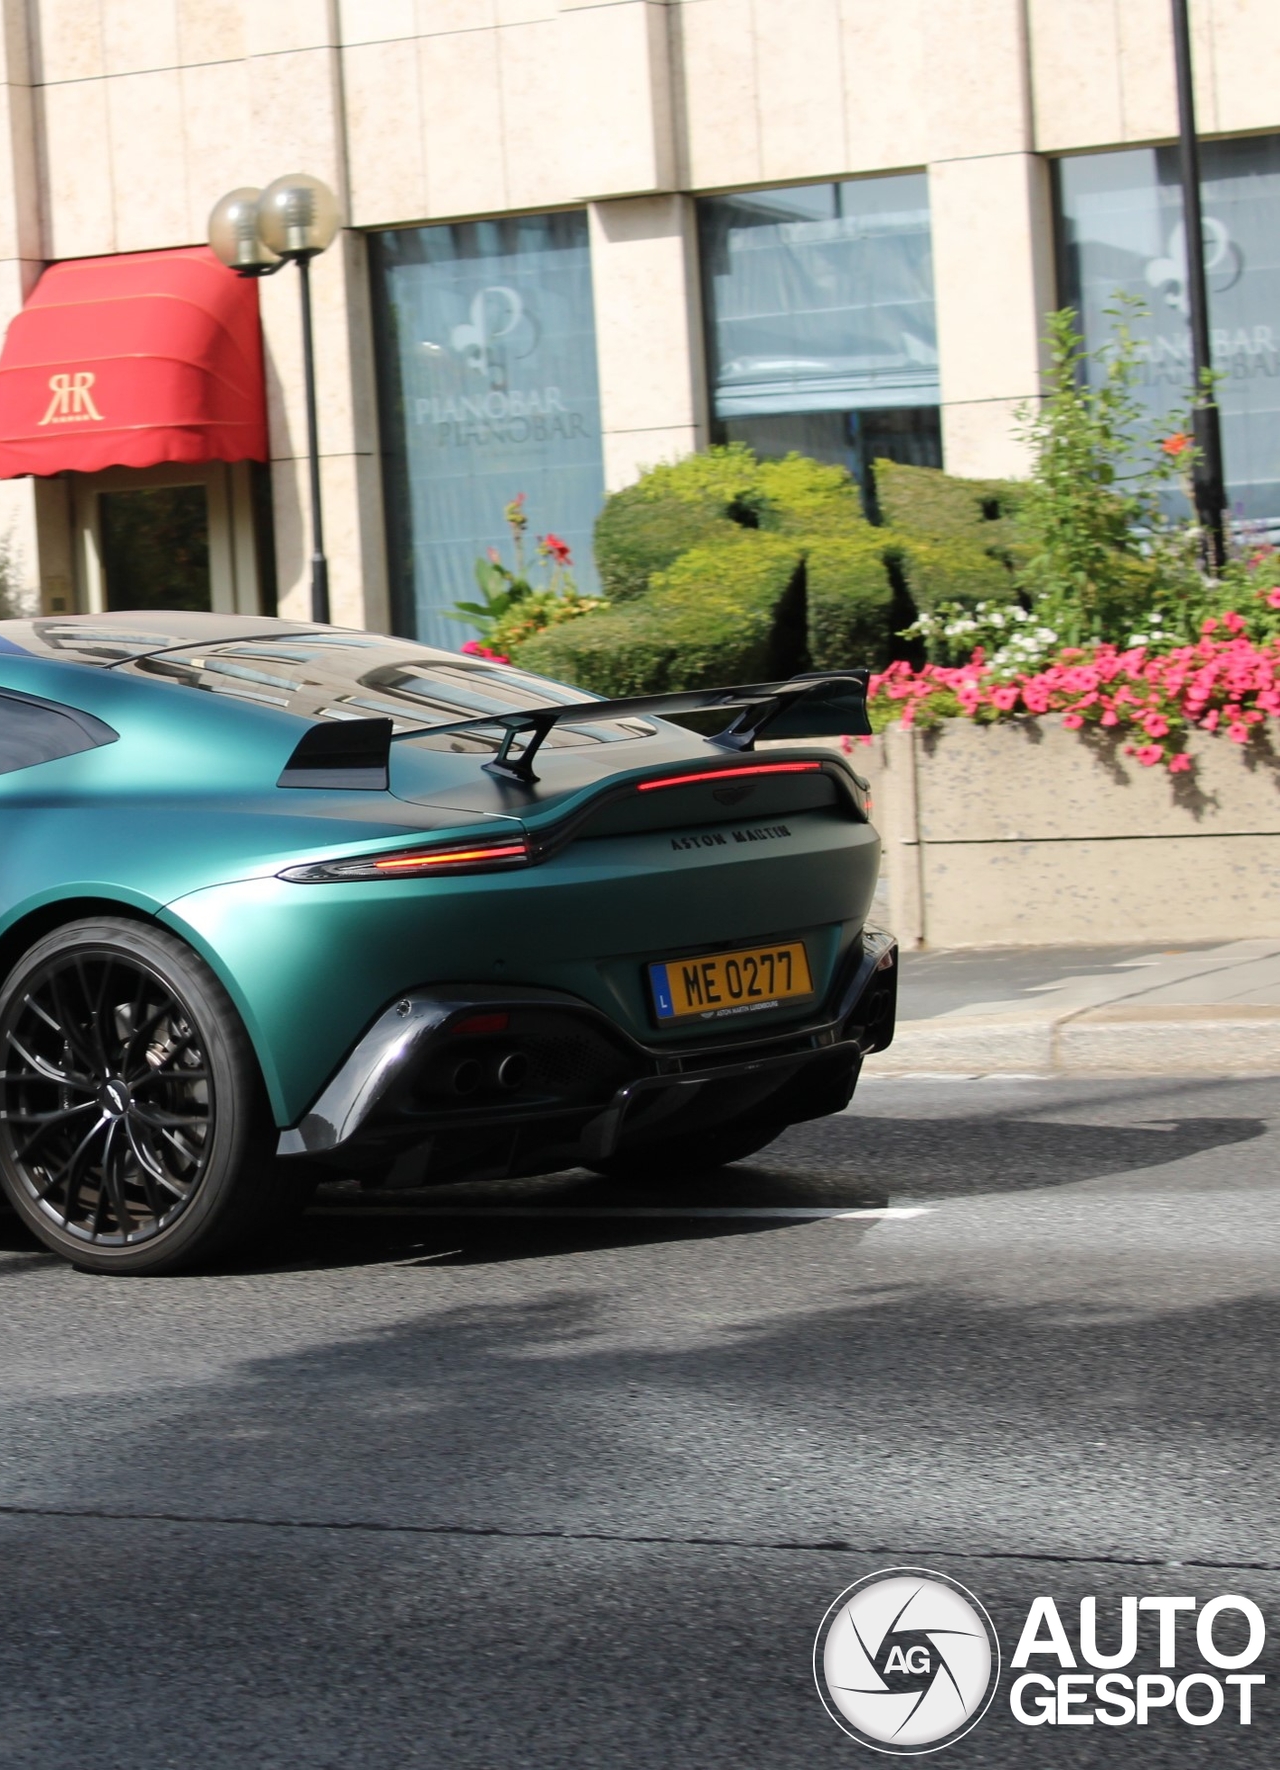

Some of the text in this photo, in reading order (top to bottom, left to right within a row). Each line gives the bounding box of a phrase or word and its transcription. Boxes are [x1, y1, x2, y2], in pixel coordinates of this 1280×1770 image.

[415, 387, 570, 424] PIANOBAR
[671, 825, 791, 851] ASTON MARTIN
[682, 951, 792, 1006] ME 0277
[659, 995, 668, 1008] L
